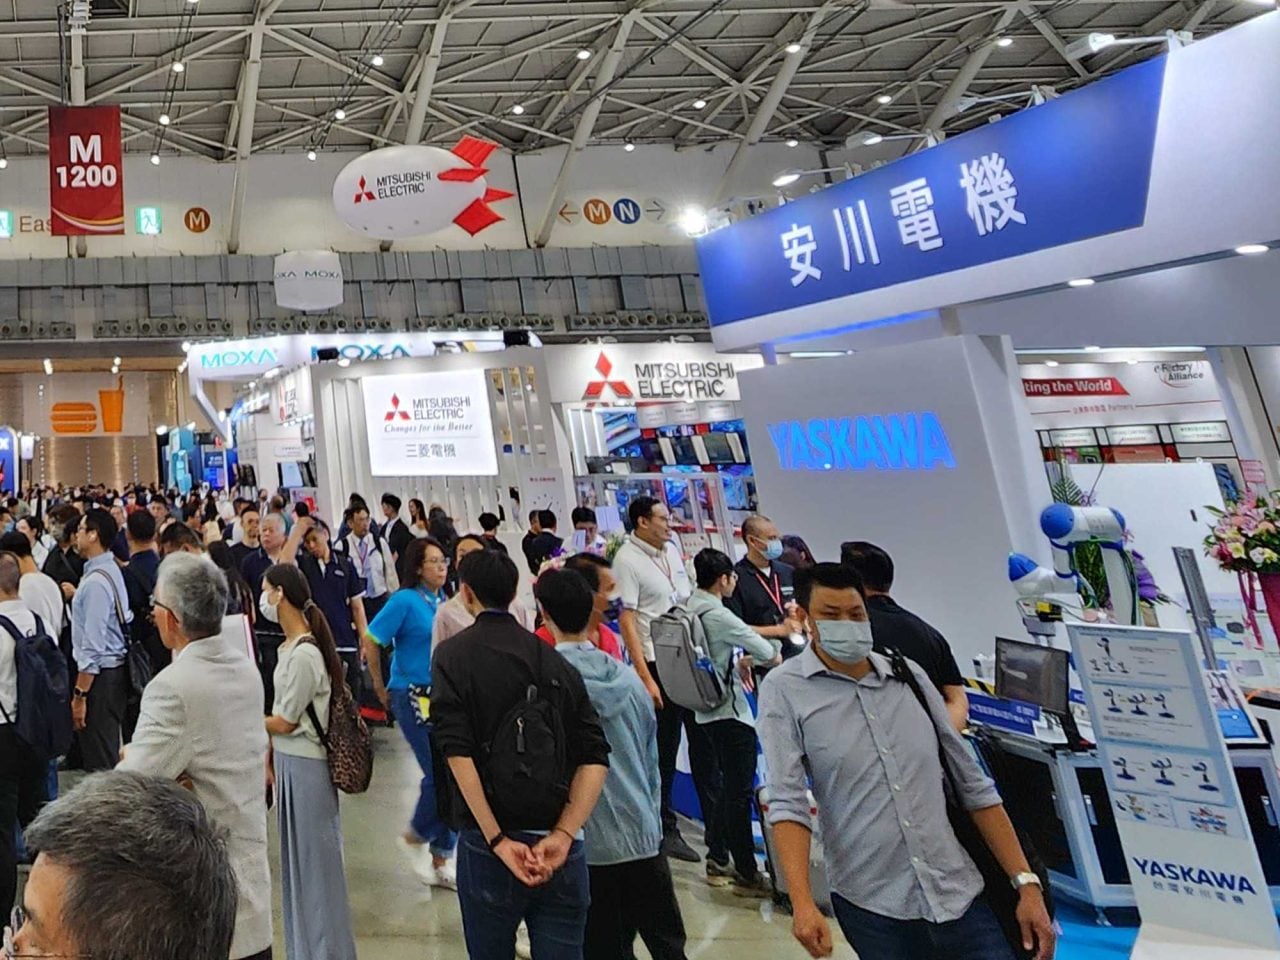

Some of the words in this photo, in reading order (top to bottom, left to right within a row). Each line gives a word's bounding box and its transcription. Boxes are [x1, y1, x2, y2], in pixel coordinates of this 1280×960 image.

[69, 134, 102, 163] M
[56, 164, 118, 188] 1200
[376, 171, 432, 187] MITSUBISHI
[377, 183, 425, 200] ELECTRIC
[189, 211, 206, 230] M
[588, 202, 607, 221] M
[618, 202, 636, 221] N
[780, 151, 1027, 287] 安川電機
[20, 215, 52, 233] Eas
[201, 348, 277, 369] MOXA
[634, 362, 736, 380] MITSUBISHI
[1167, 371, 1204, 382] Alliance
[637, 379, 726, 399] ELECTRIC
[1052, 380, 1074, 392] the
[1076, 379, 1112, 392] World
[412, 396, 471, 409] MITSUBISHI
[414, 408, 464, 421] ELECTRIC
[384, 423, 417, 434] Changes
[419, 423, 431, 433] for
[432, 422, 446, 431] the
[447, 421, 474, 431] Better
[767, 411, 957, 471] YASKAWA
[405, 443, 457, 458] 三菱電機
[1132, 856, 1257, 896] YASKAWA
